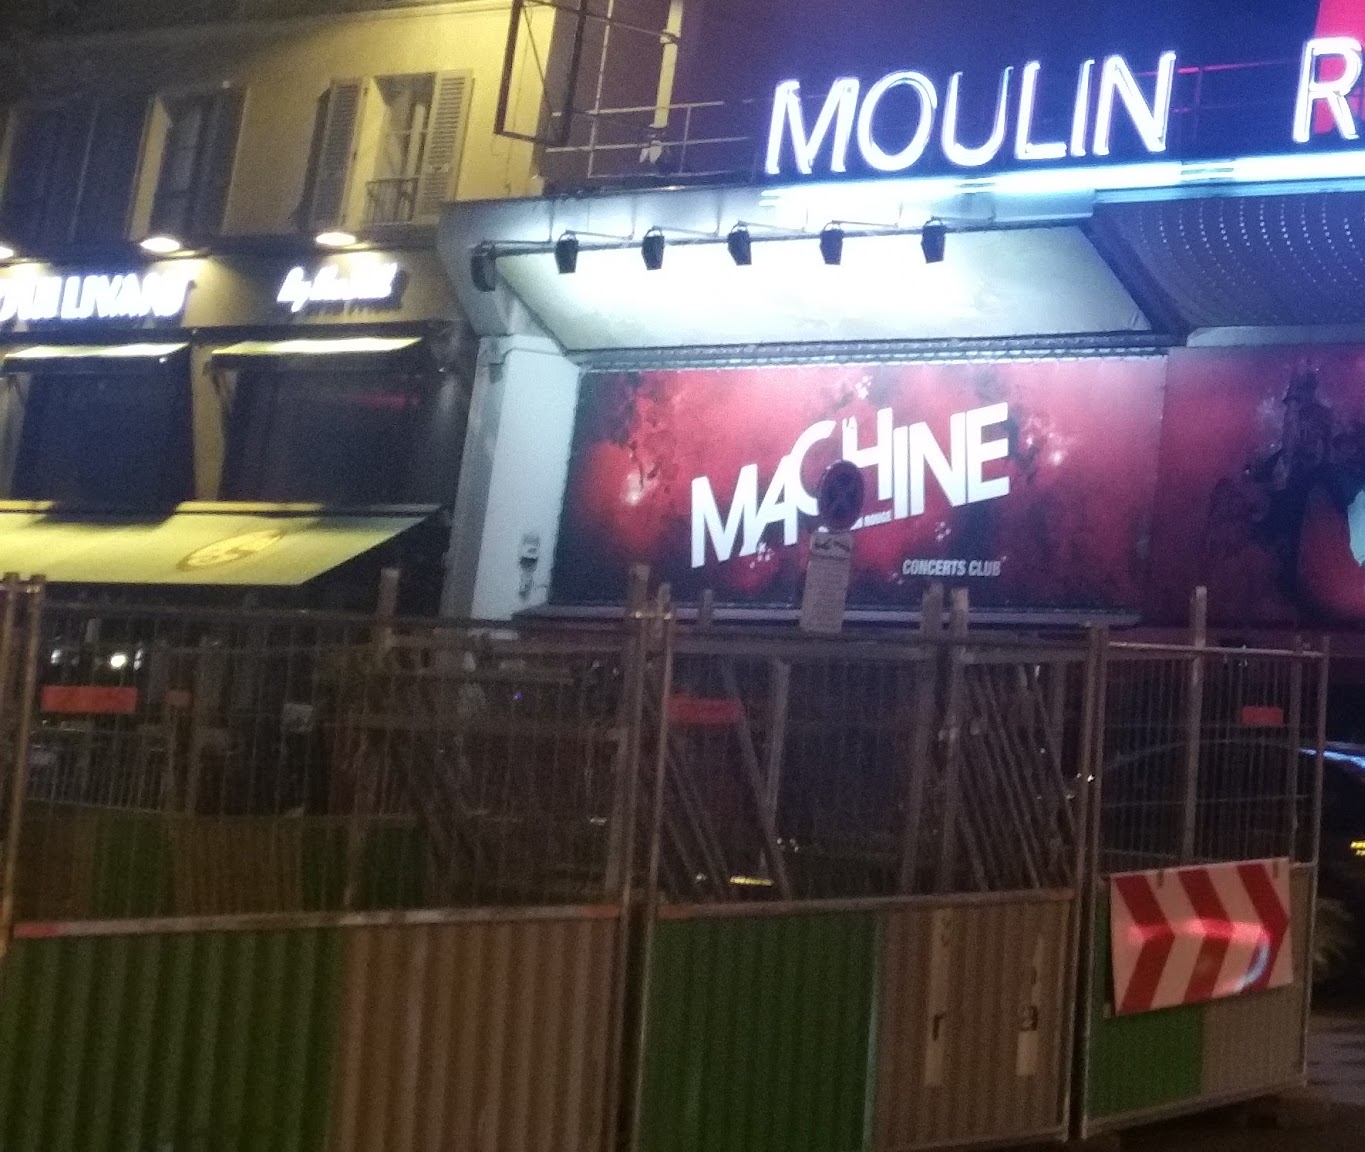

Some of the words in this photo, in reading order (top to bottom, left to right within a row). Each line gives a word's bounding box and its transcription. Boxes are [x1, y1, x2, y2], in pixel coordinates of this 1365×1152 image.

[764, 50, 1177, 176] MOULIN
[690, 401, 1011, 570] MACHINE
[902, 558, 966, 576] CONCERTS
[968, 560, 1001, 577] CLUB
